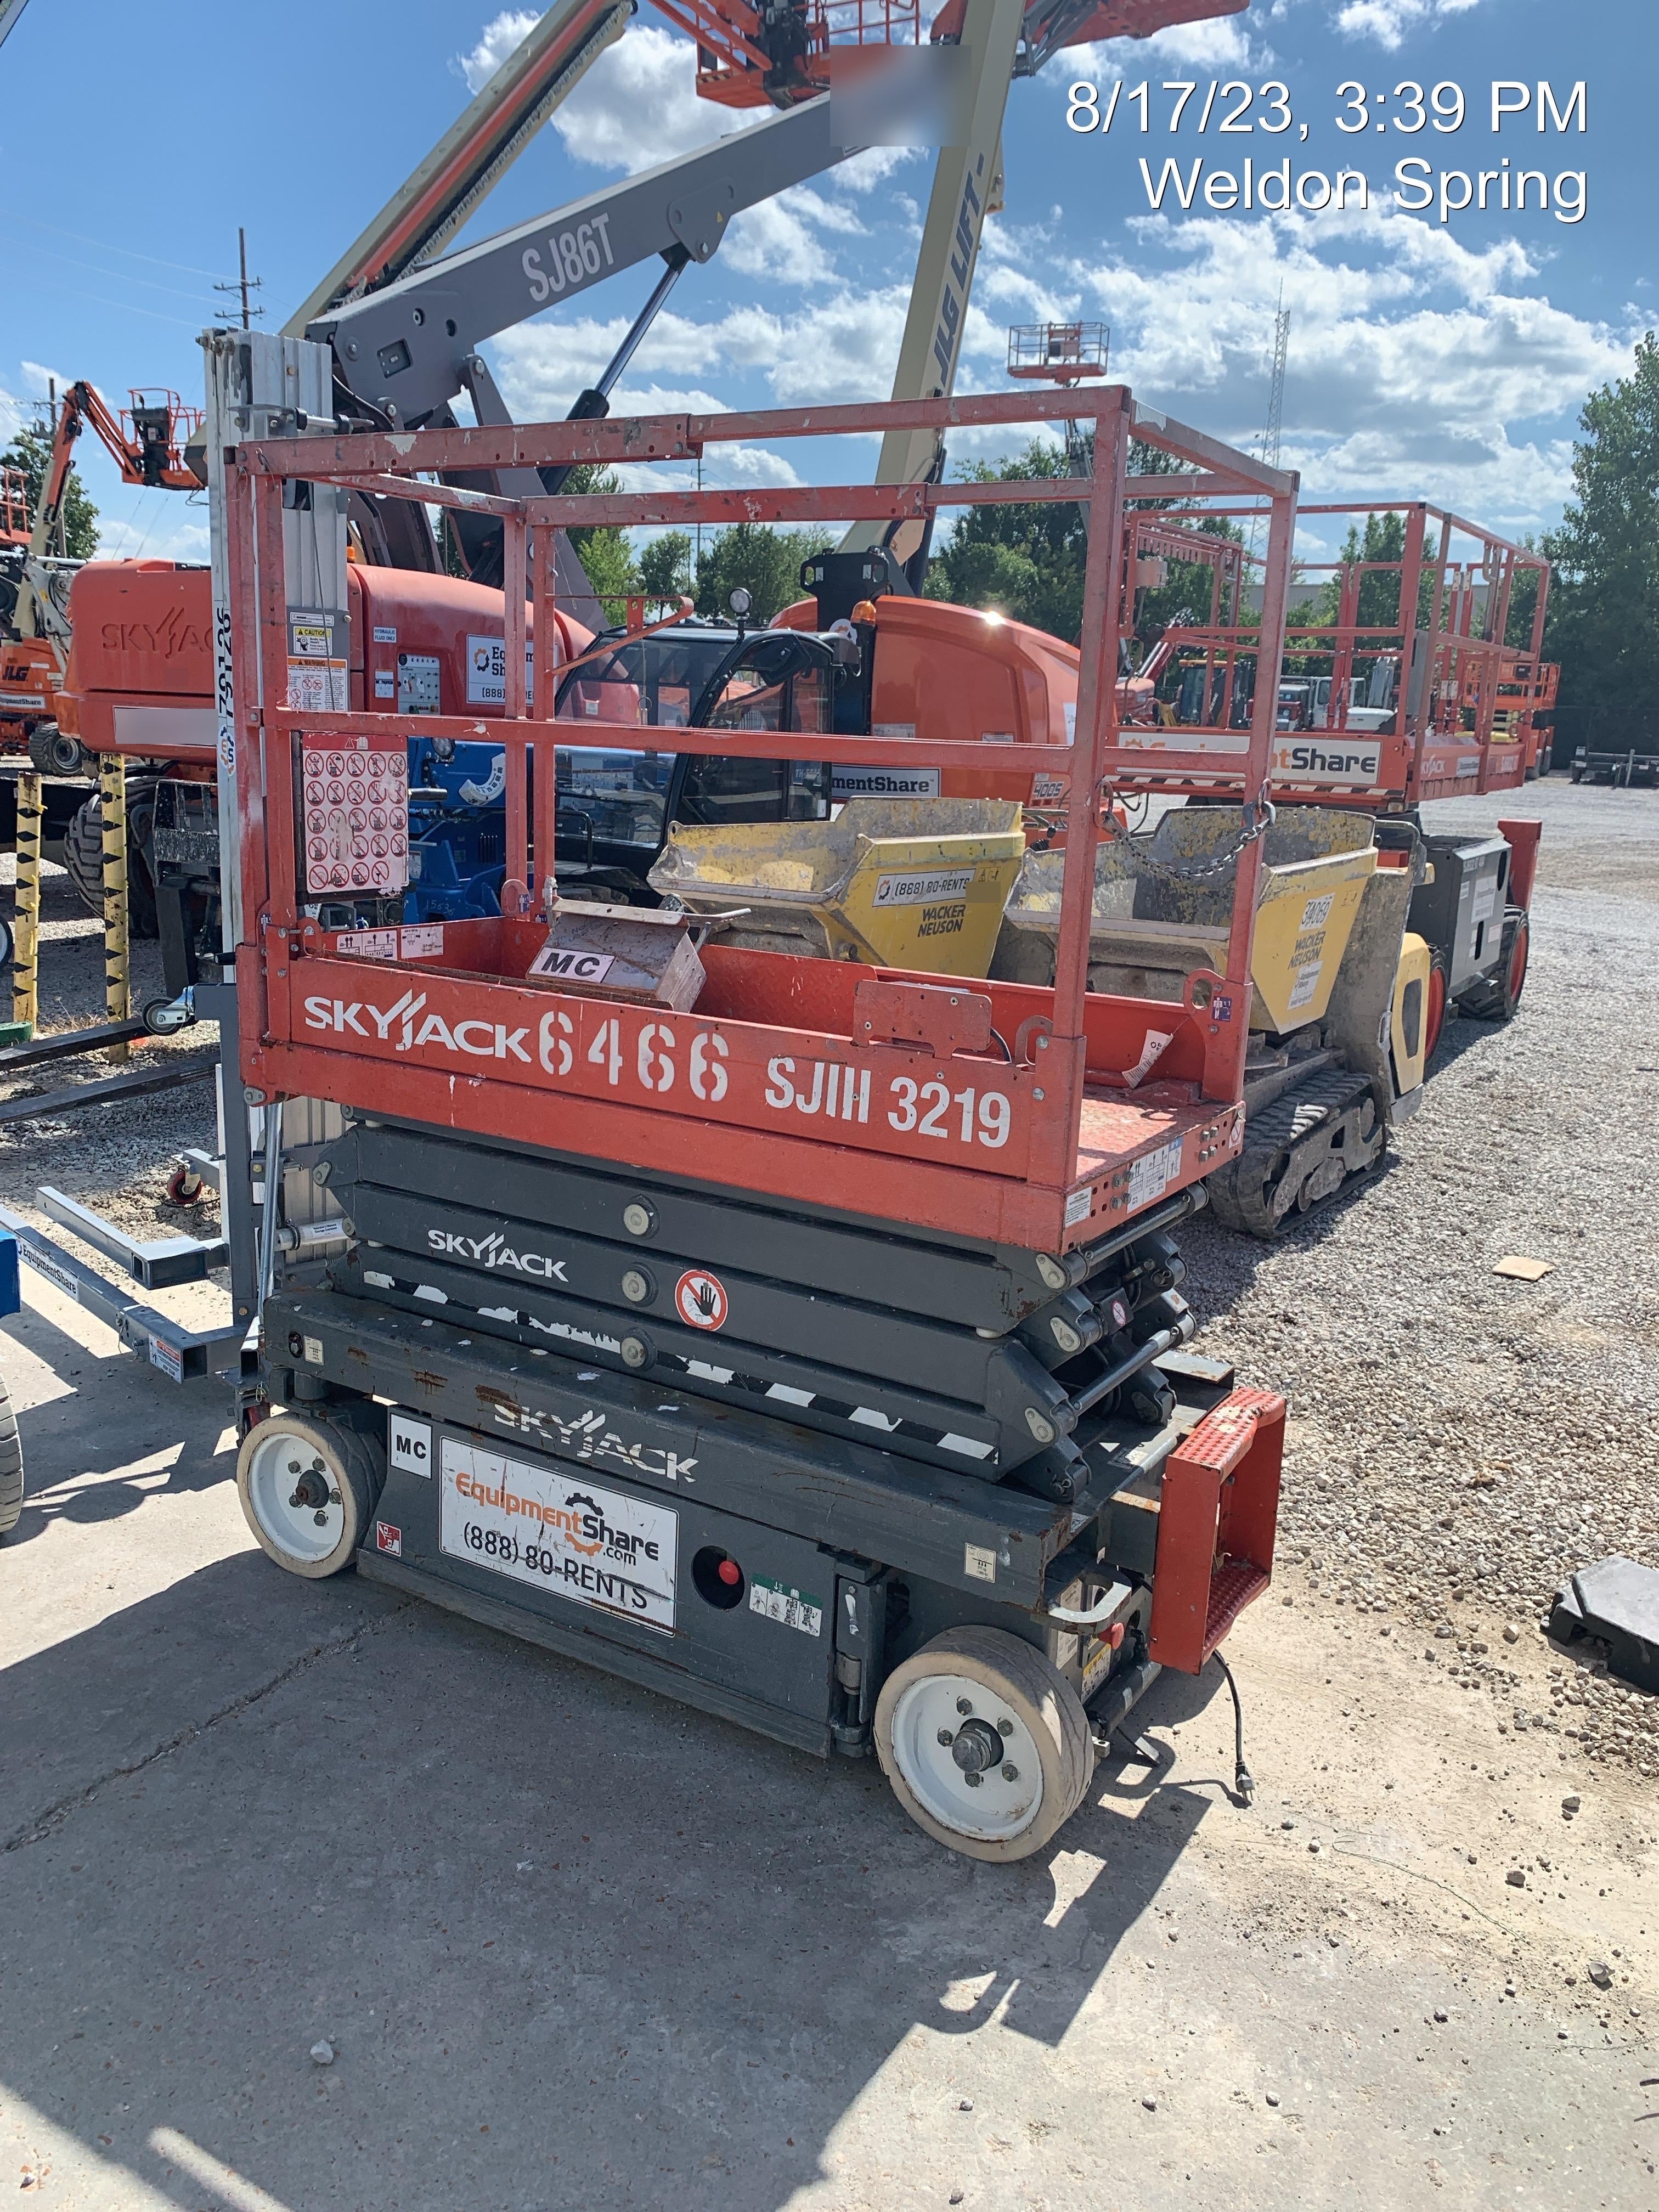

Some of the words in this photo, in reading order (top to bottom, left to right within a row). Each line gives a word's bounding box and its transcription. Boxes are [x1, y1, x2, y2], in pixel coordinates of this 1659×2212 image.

[522, 212, 614, 302] SJ86T
[934, 282, 960, 388] JLG
[950, 169, 981, 293] LIFT
[2, 665, 30, 681] JLG
[831, 776, 929, 792] mentShare
[1034, 782, 1063, 798] 400S
[894, 881, 924, 896] (888)
[927, 877, 970, 894] 80-RENTS
[922, 904, 966, 922] WACKER
[917, 918, 964, 938] NEUSON
[1294, 930, 1327, 953] WACKER
[540, 952, 600, 977] MC
[1287, 946, 1322, 970] NEUSON
[304, 989, 532, 1063] SKYJACK
[539, 1011, 729, 1102] 6466
[887, 1076, 1011, 1148] 3219
[427, 1229, 569, 1283] SKYJACK
[22, 1244, 76, 1294] EquipmentShare
[396, 1434, 426, 1459] MC
[494, 1403, 699, 1483] SKYJACK
[455, 1472, 659, 1561] EquipmentShare
[464, 1521, 519, 1565] (888)
[525, 1544, 648, 1610] 80-RENTS
